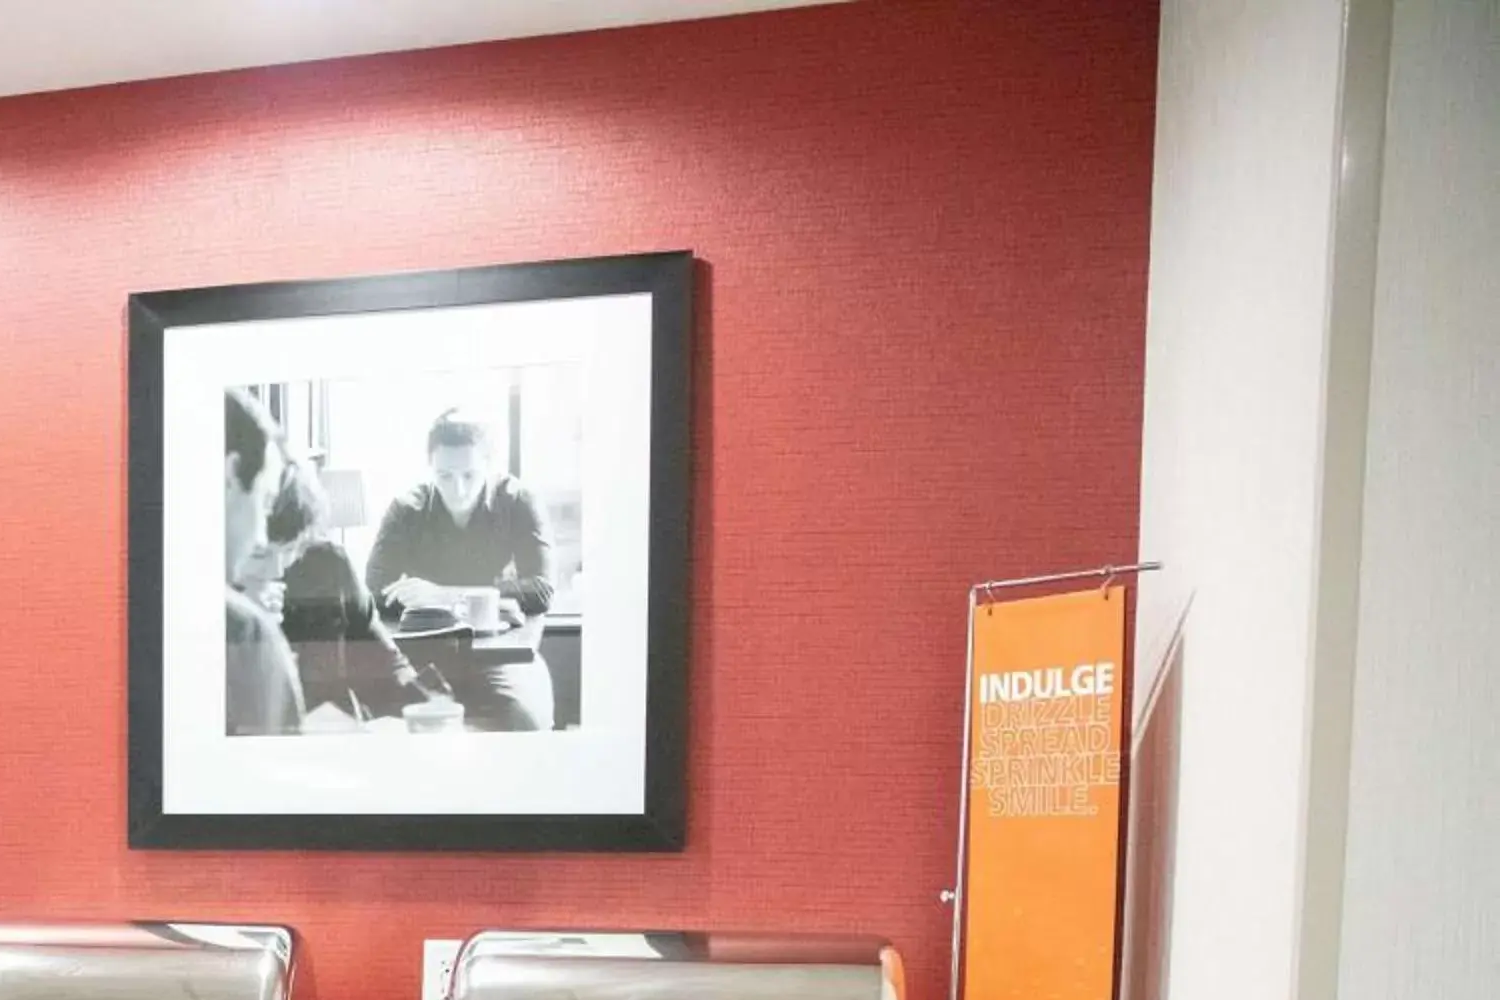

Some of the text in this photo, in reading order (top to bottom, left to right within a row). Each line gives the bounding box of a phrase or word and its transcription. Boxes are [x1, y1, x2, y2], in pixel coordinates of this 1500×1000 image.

[979, 662, 1114, 703] INDULGE
[983, 698, 1111, 731] DRIZZLE
[981, 723, 1111, 757] SPREAD
[971, 750, 1121, 787] SPRINKLE
